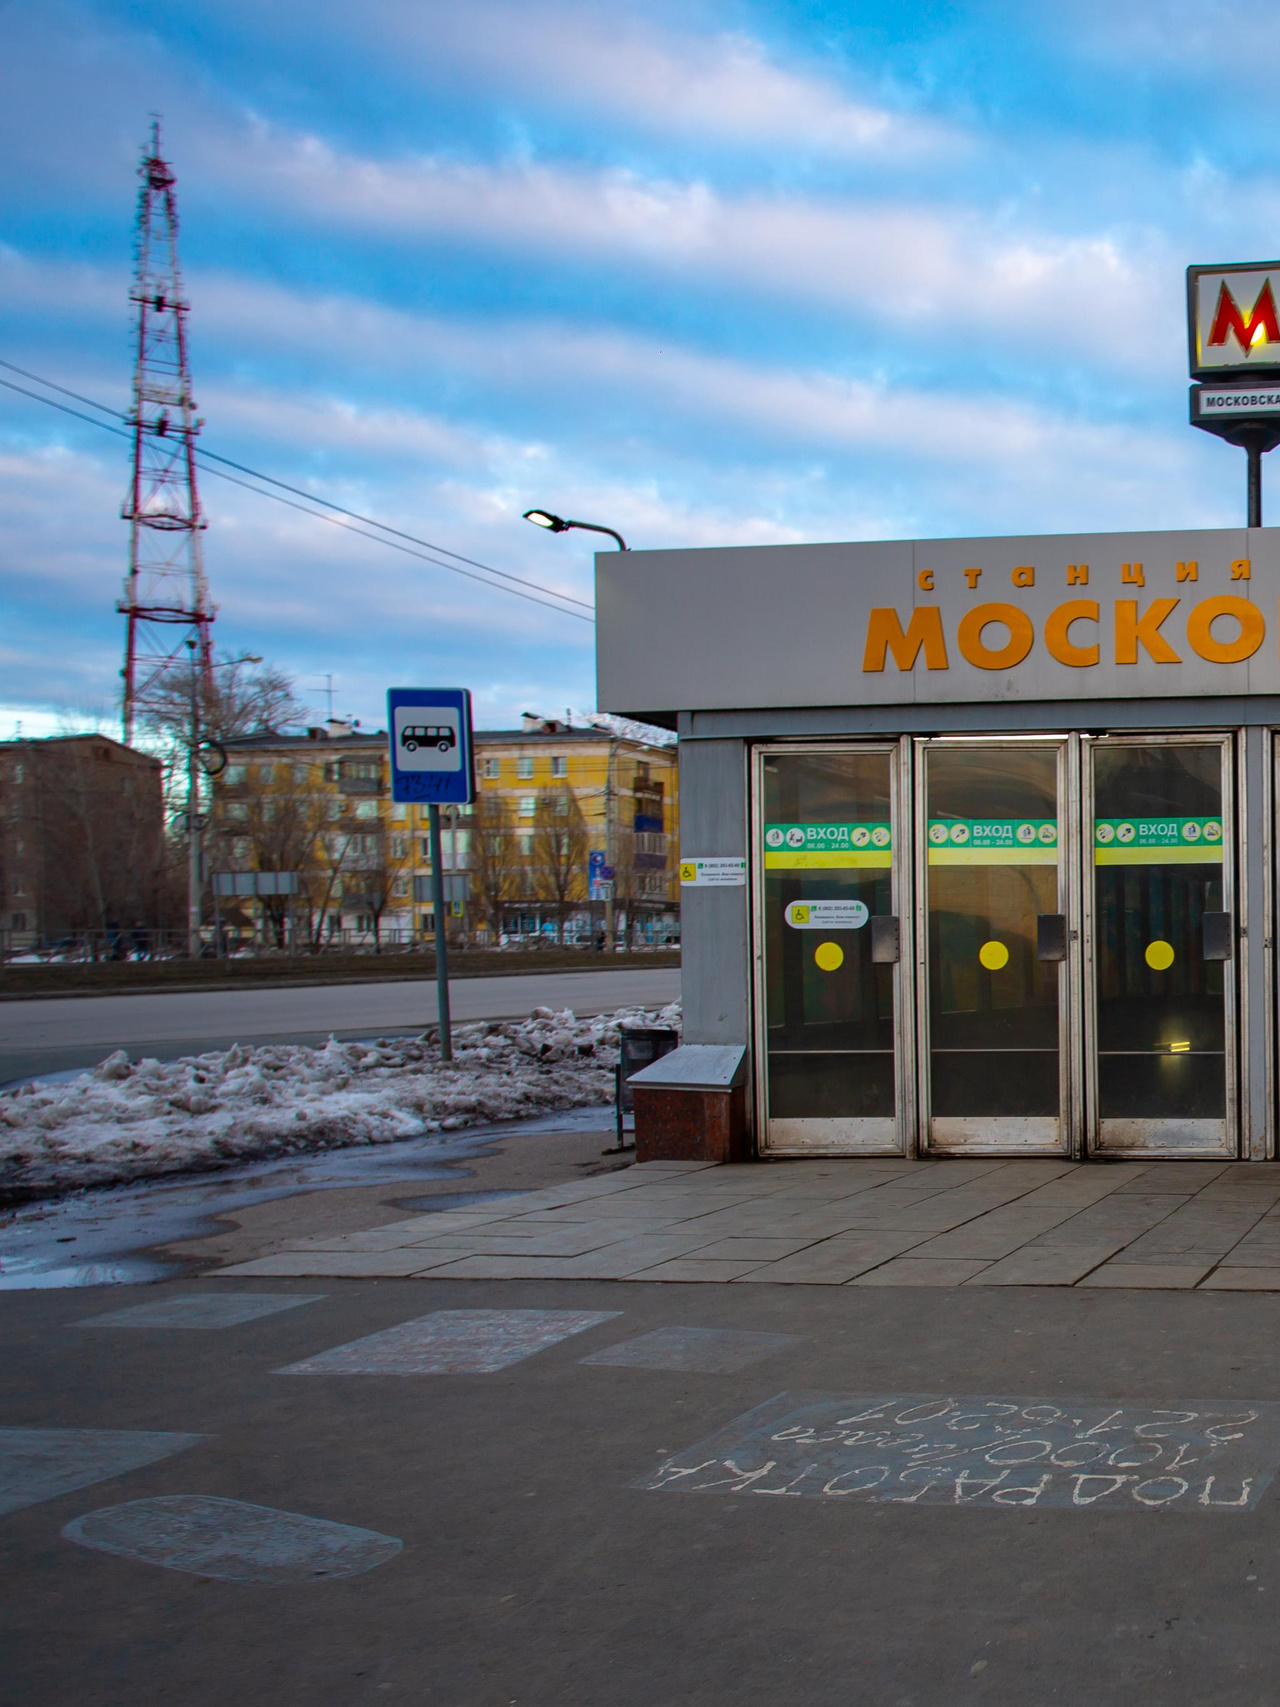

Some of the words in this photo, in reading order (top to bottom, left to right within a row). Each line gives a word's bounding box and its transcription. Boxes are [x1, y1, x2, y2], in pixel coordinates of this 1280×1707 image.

[917, 559, 1251, 591] станция
[806, 827, 849, 841] ВХОД
[973, 825, 1013, 839] ВХОД
[1139, 824, 1178, 837] ВХОД
[646, 1458, 1252, 1505] ПОДРАБОТКА
